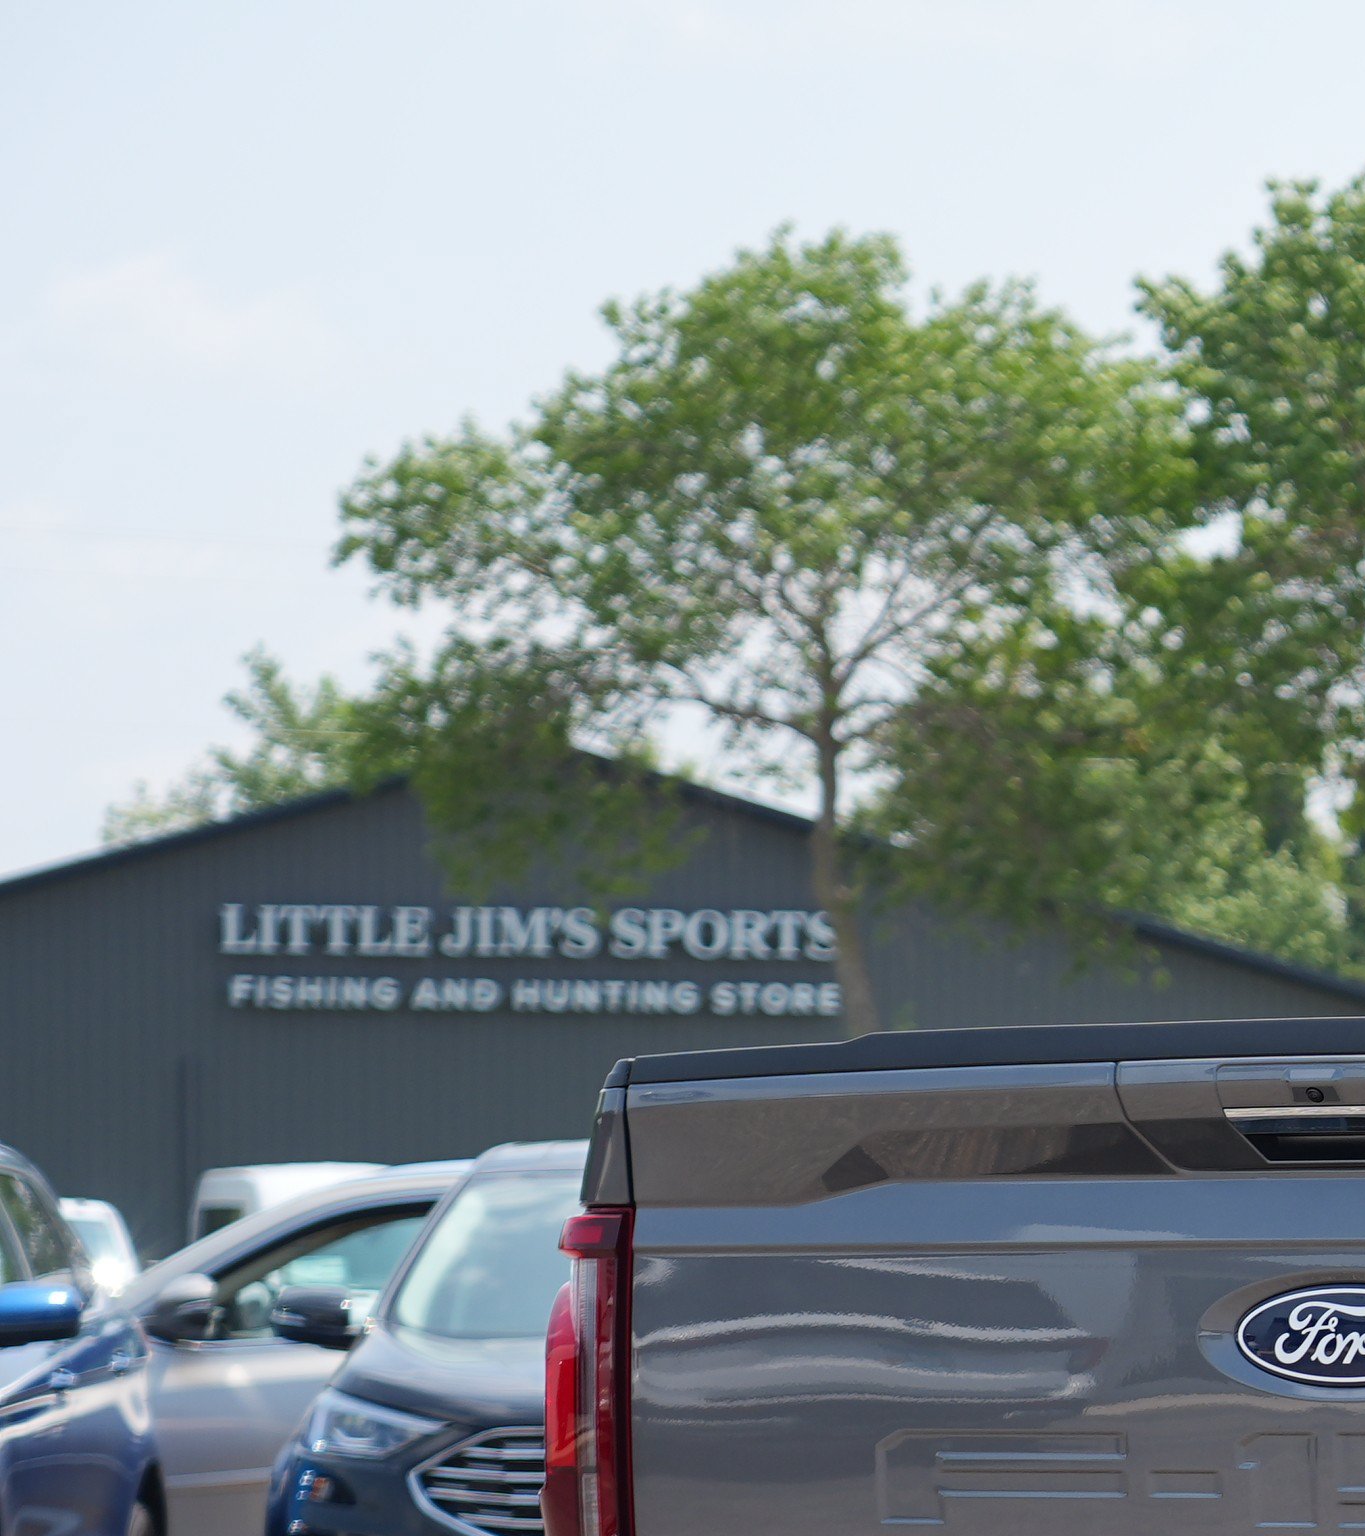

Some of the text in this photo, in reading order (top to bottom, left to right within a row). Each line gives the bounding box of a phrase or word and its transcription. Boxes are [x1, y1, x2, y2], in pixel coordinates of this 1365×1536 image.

[221, 903, 837, 962] LITTLE JIM'S SPORTS
[229, 974, 841, 1017] FISHING AND HUNTING STORE
